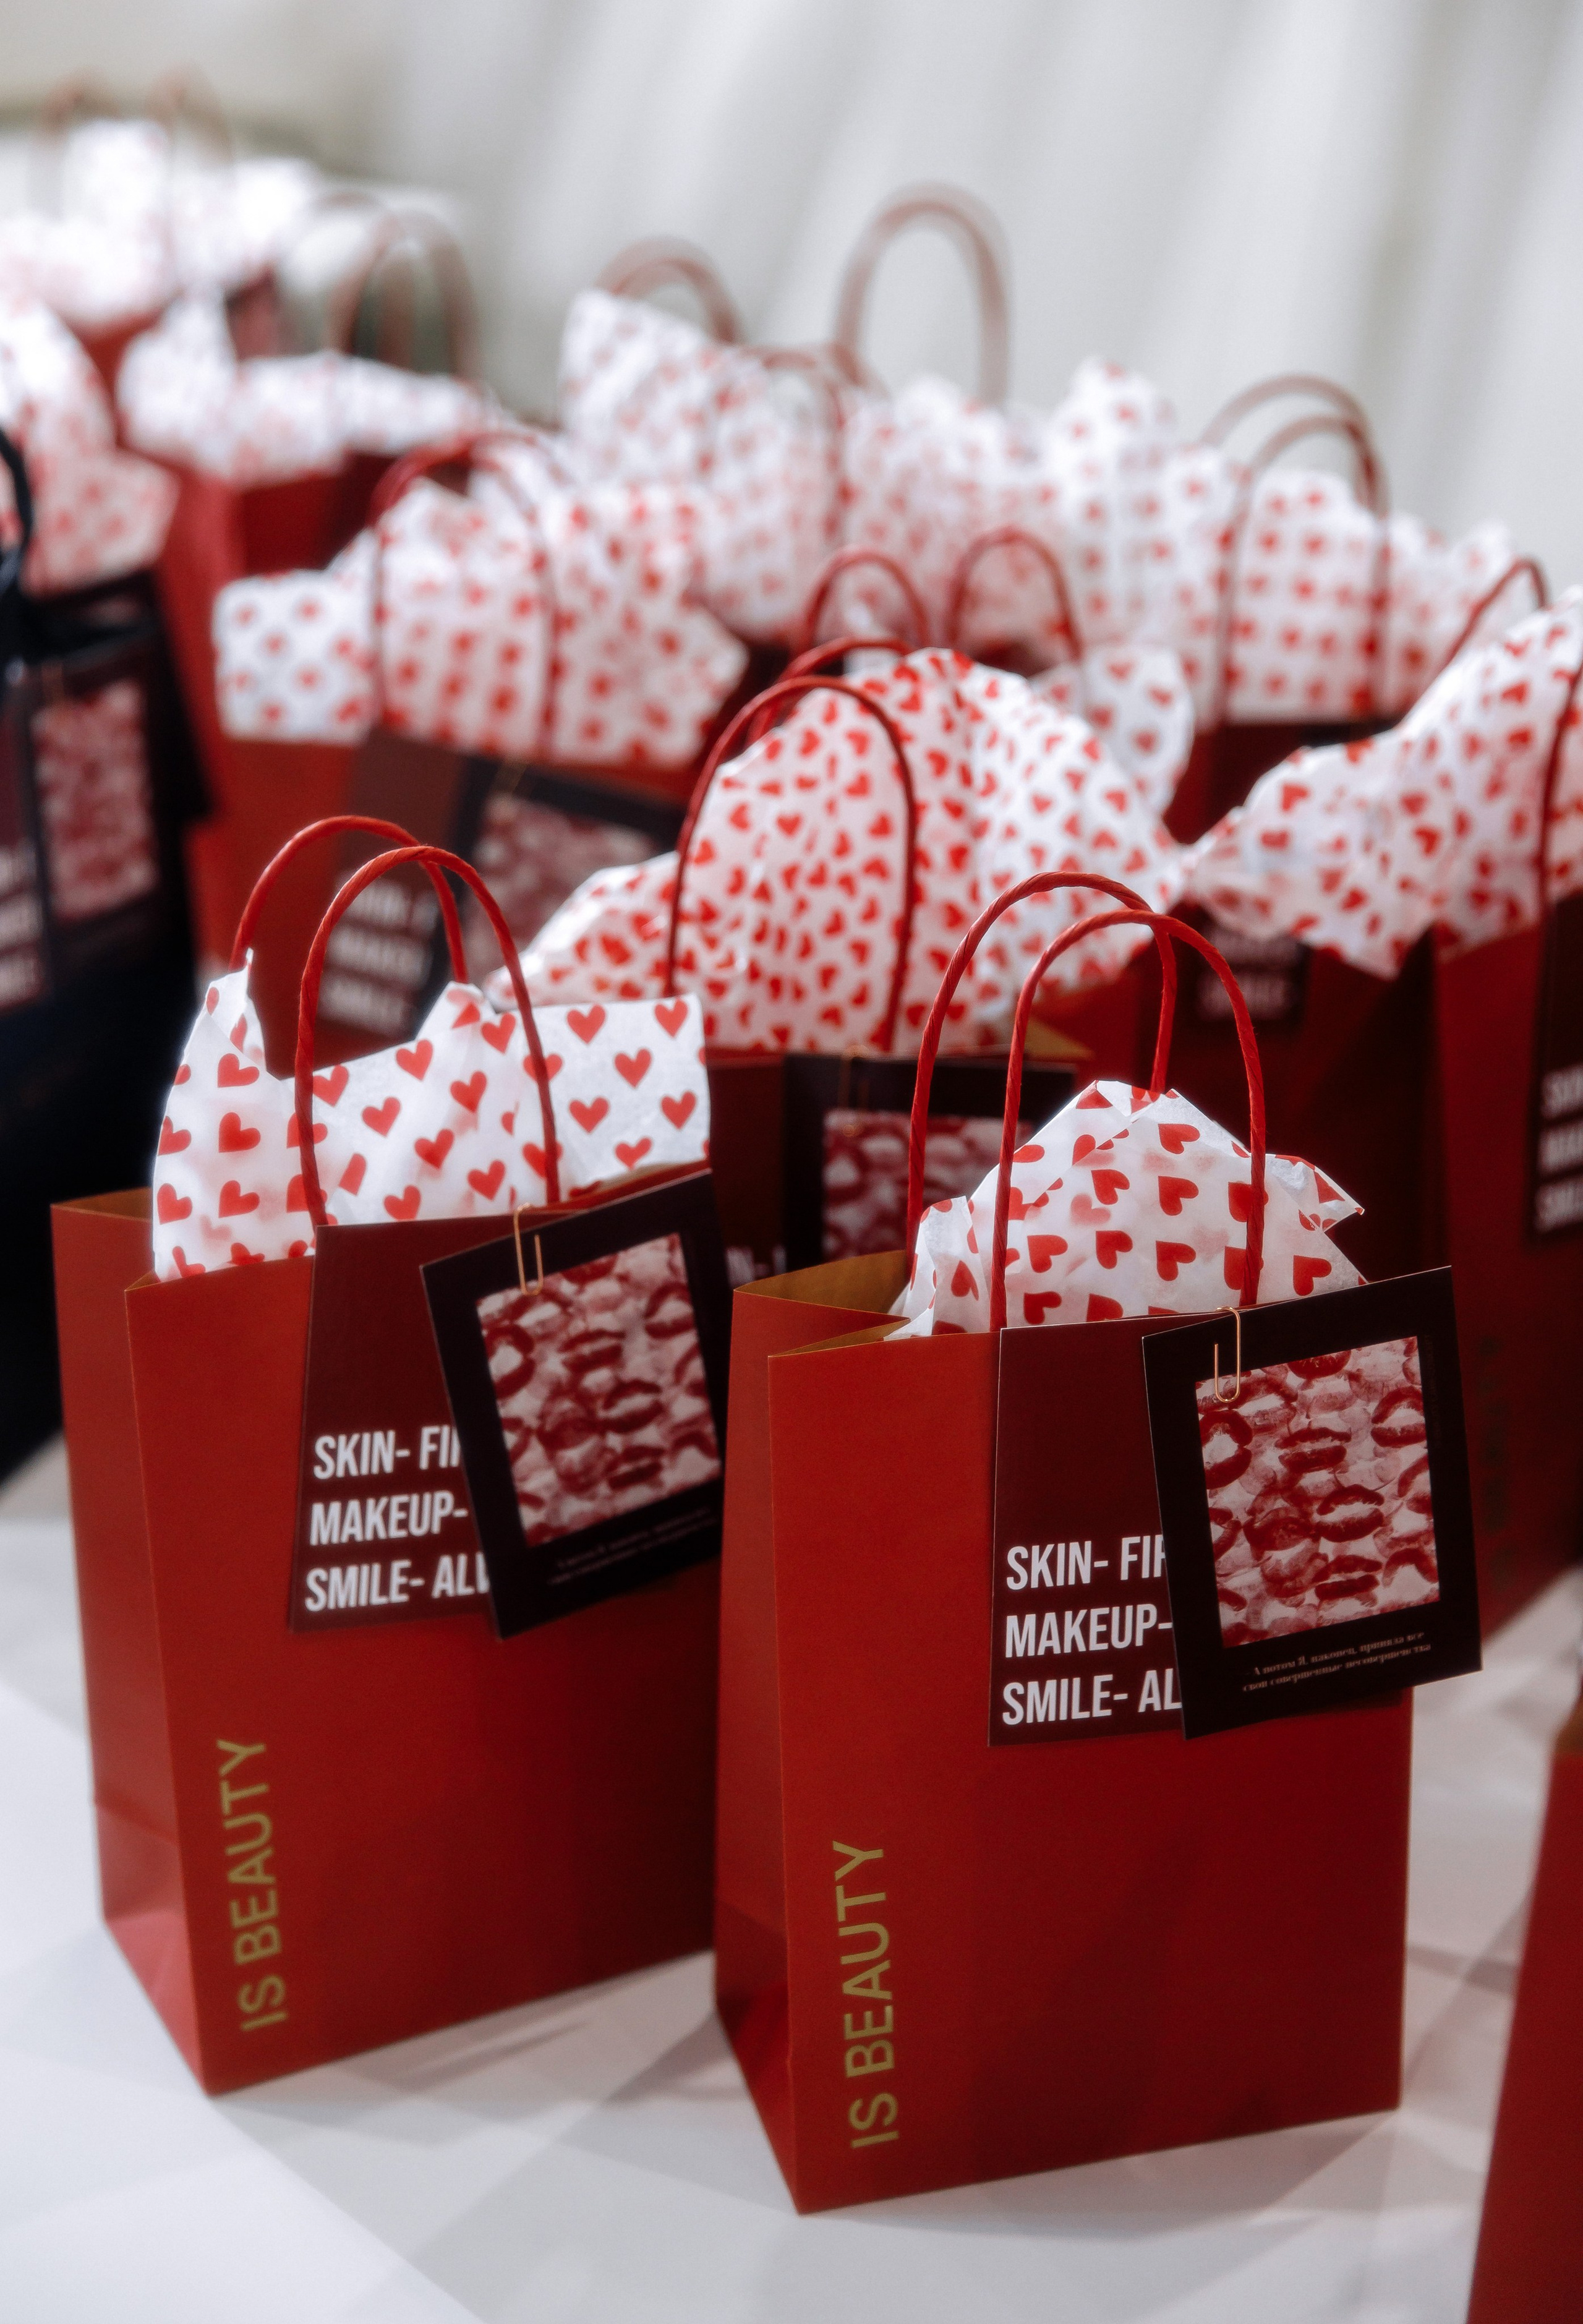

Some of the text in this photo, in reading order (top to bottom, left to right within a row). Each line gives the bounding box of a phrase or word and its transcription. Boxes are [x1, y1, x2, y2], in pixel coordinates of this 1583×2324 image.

[314, 1430, 410, 1479] SKIN-
[310, 1490, 468, 1546] MAKEUP-
[305, 1559, 425, 1612] SMILE-
[1007, 1540, 1108, 1590] SKIN-
[1005, 1604, 1173, 1658] MAKEUP-
[1002, 1674, 1128, 1725] SMILE-
[216, 1738, 288, 2031] IS BEAUTY
[832, 1840, 900, 2149] IS BEAUTY
